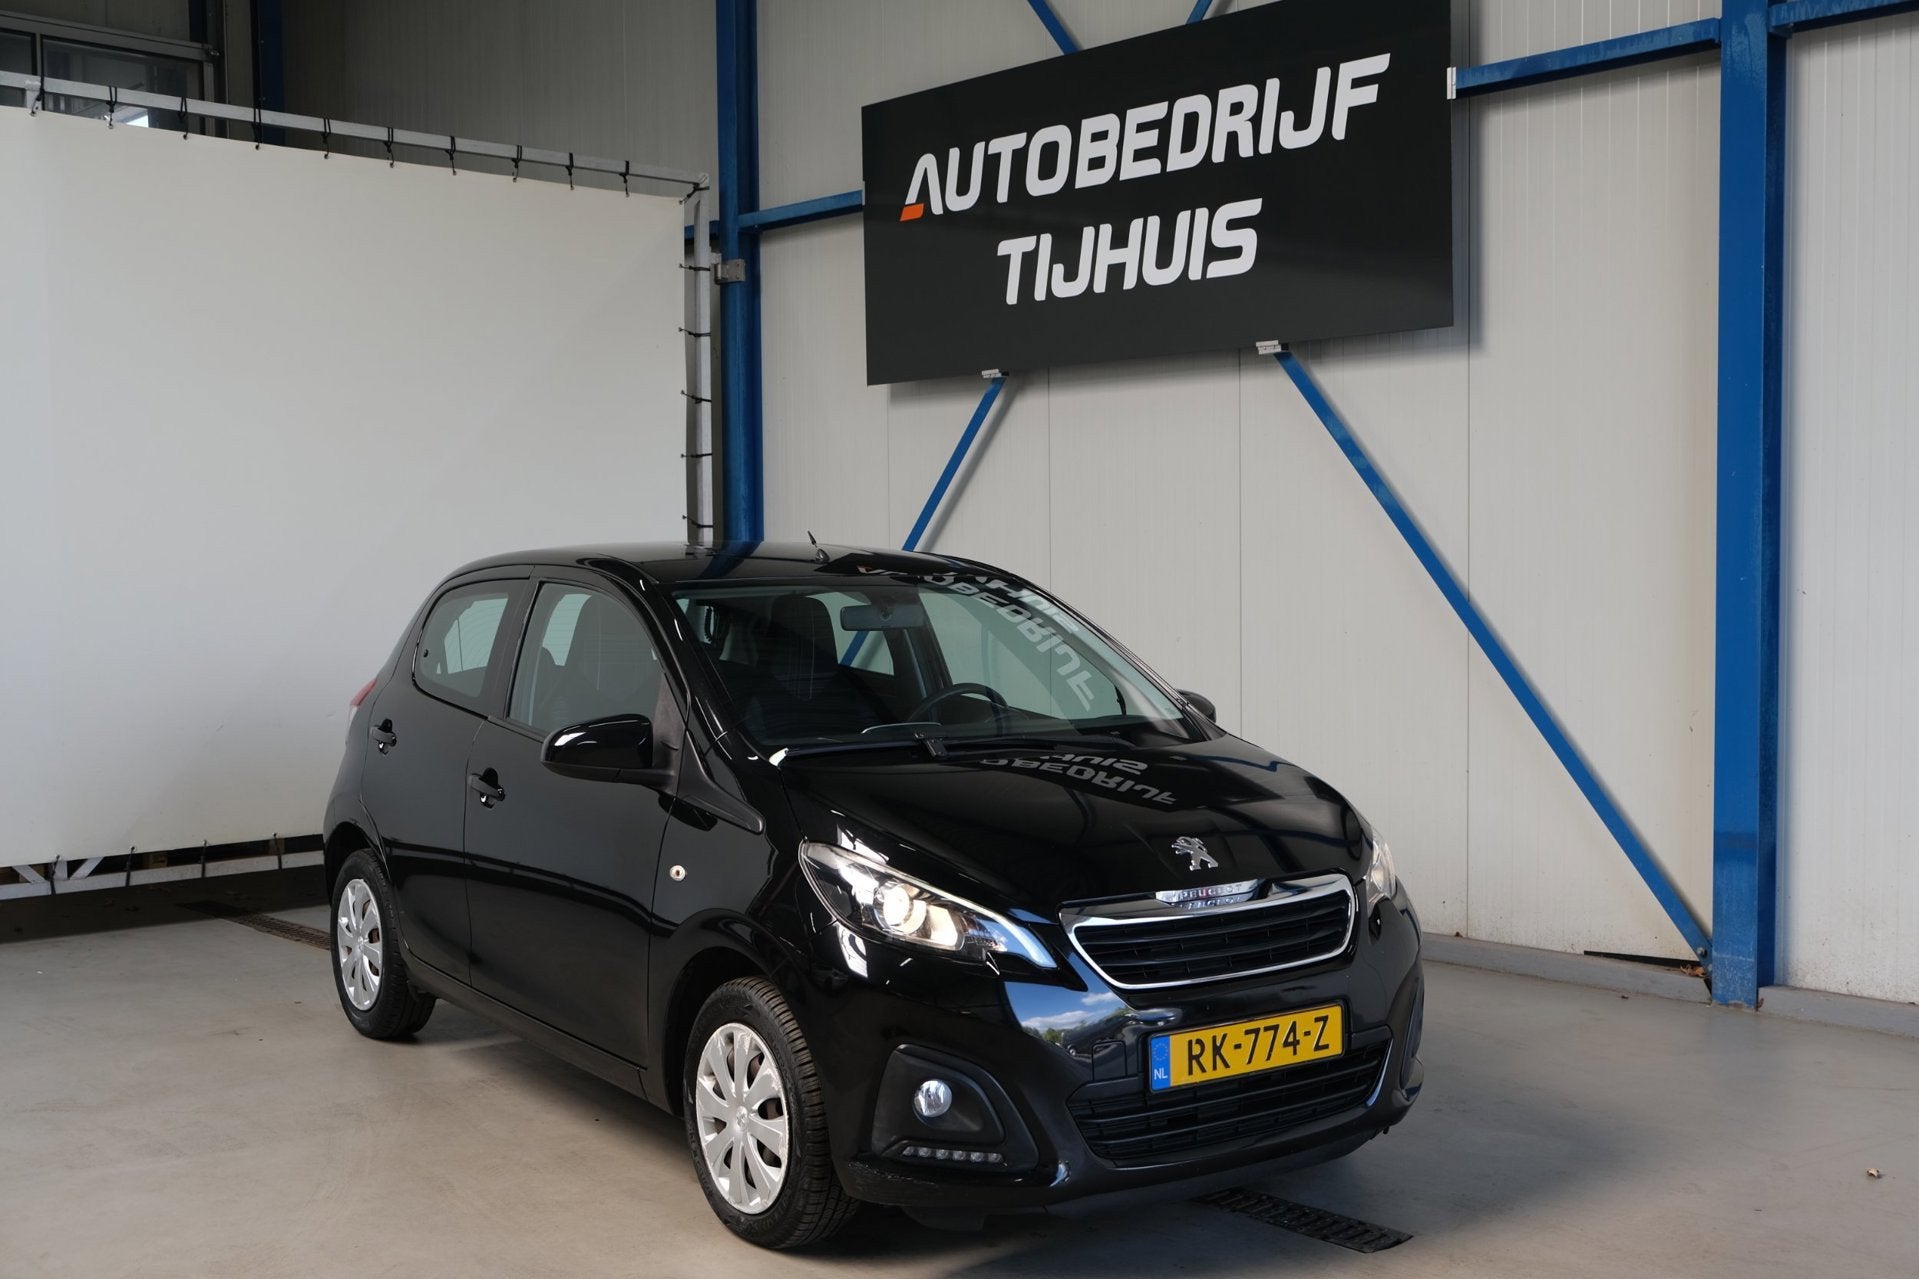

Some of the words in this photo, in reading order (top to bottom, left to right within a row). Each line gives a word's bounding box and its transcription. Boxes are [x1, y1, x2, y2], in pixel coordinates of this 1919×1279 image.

[900, 52, 1391, 222] AUTOBEDRIJF
[997, 197, 1263, 305] TIJHUIS
[1154, 1069, 1168, 1080] NL
[1187, 1014, 1330, 1076] RK-774-Z
